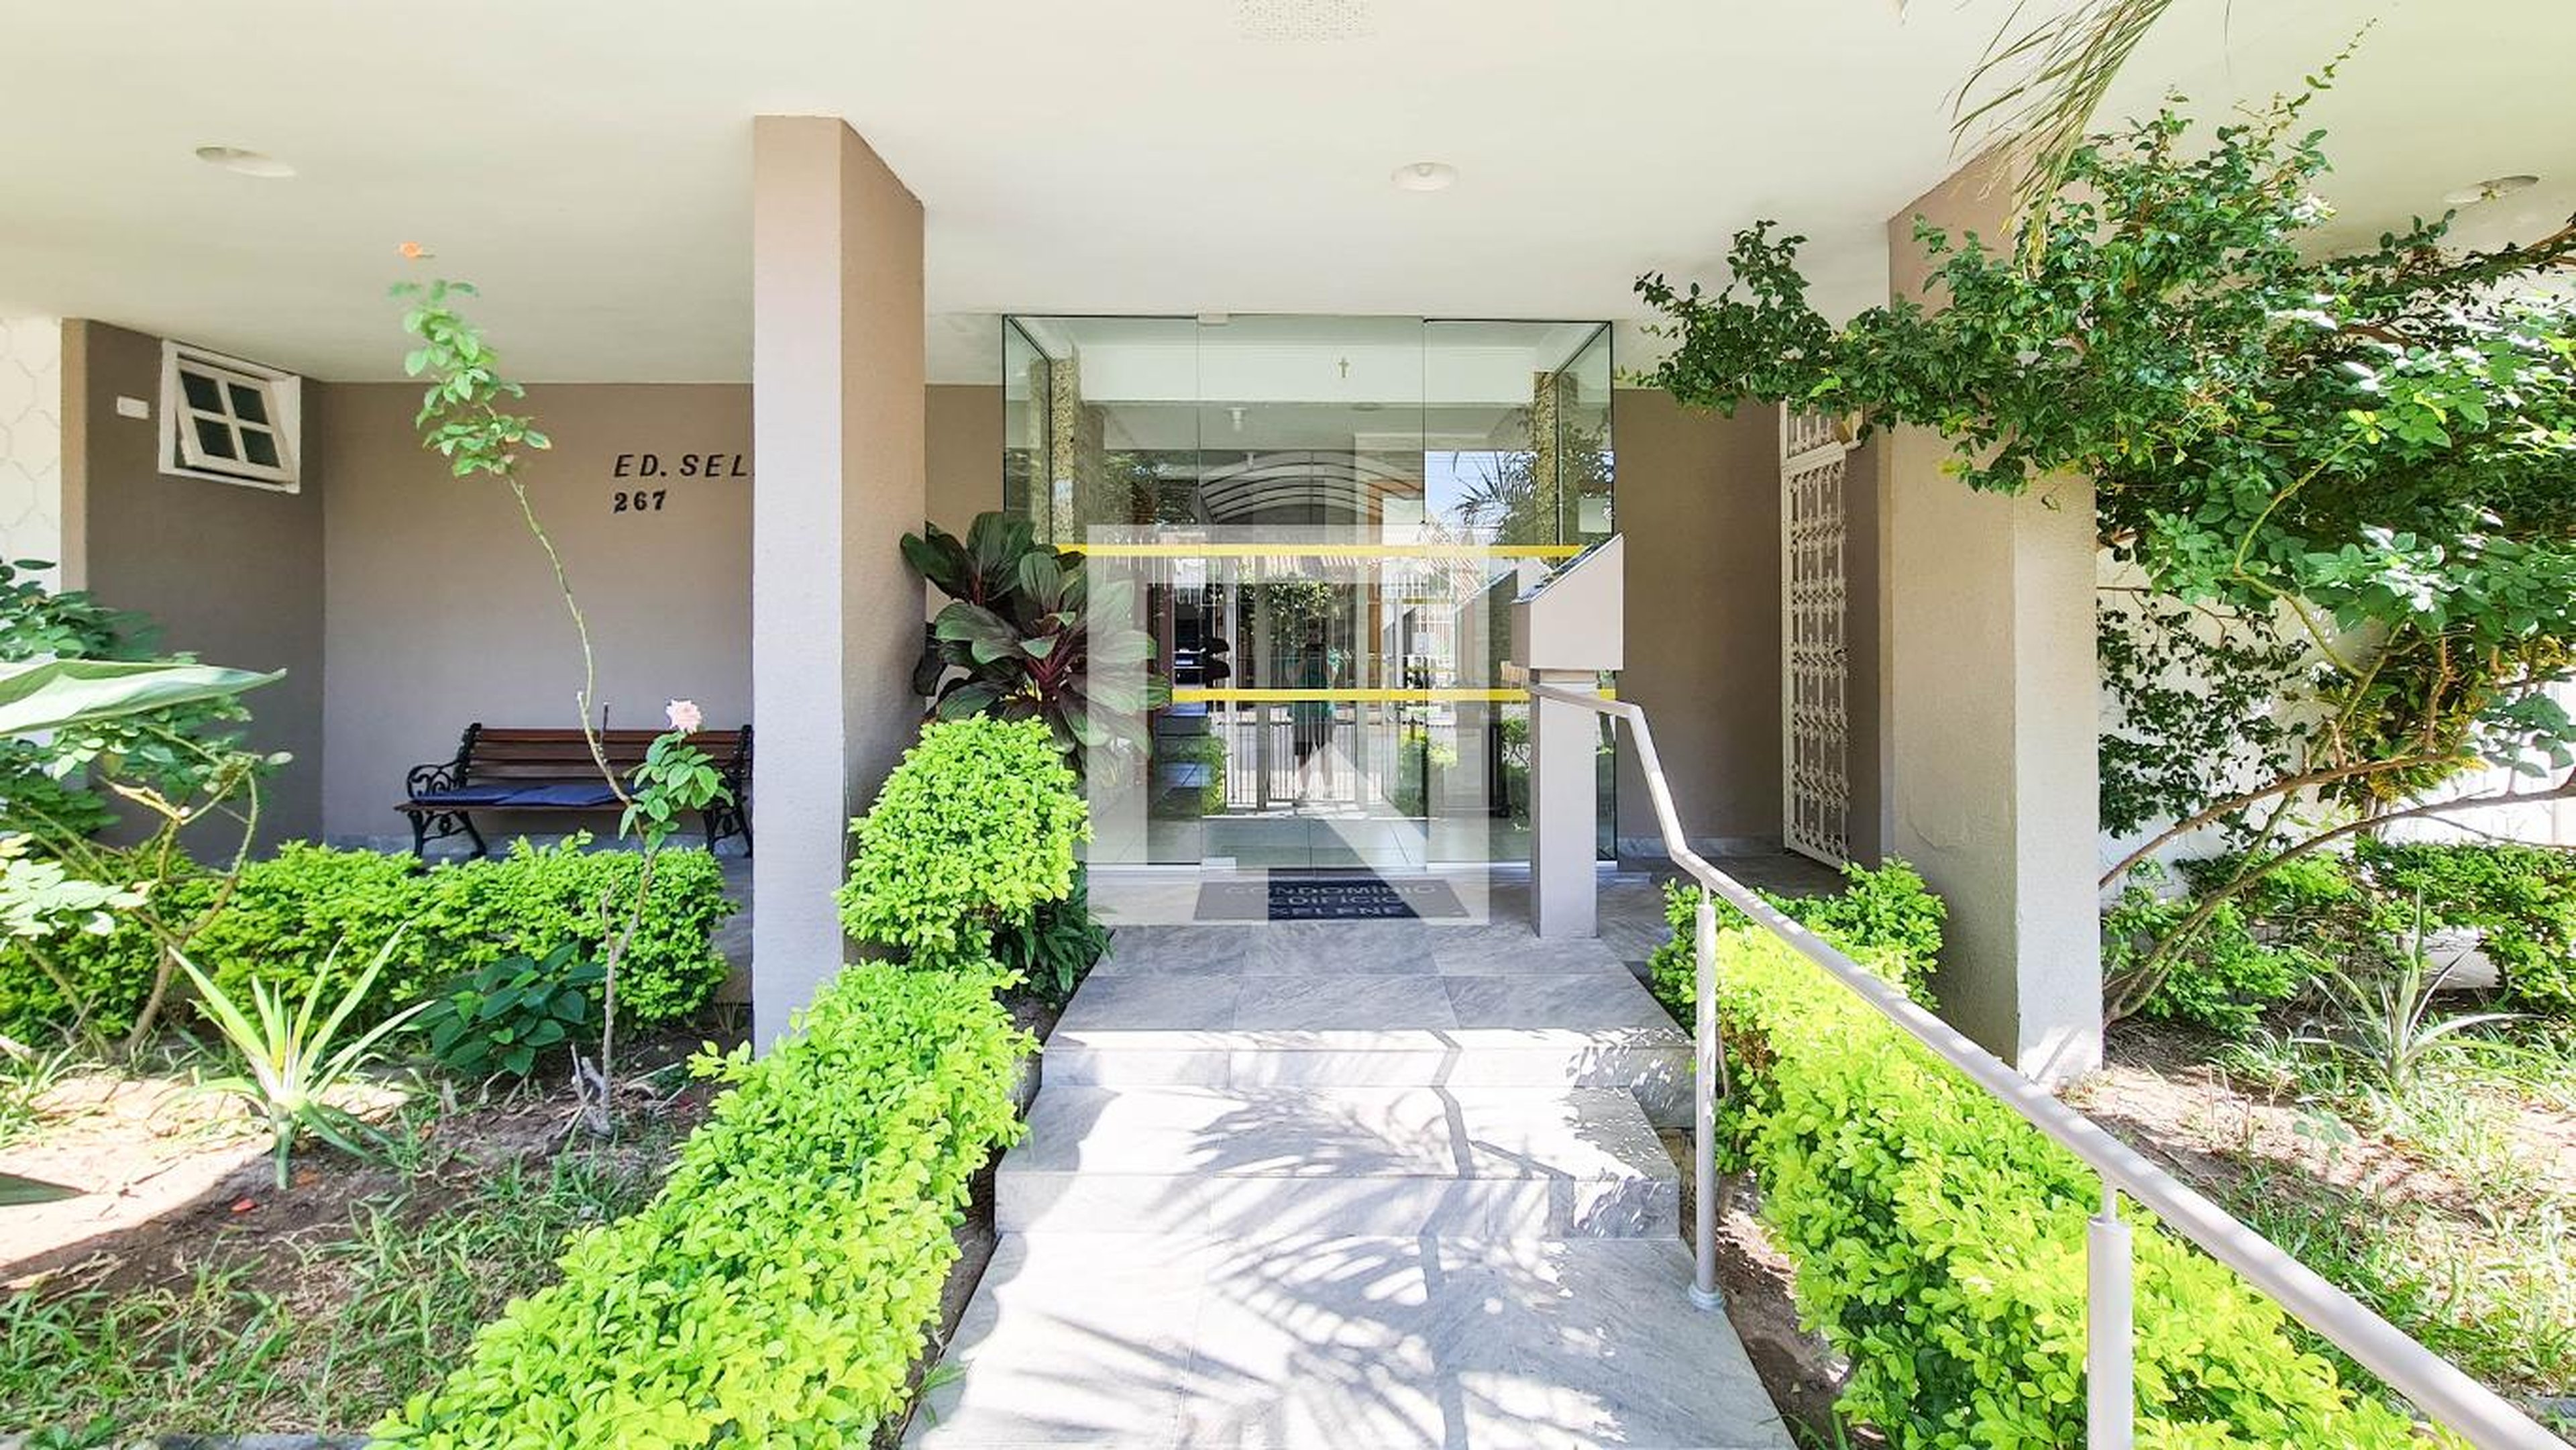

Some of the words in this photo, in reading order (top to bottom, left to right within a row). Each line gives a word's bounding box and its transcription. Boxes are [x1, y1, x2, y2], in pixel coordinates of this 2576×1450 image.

[614, 454, 667, 478] ED.
[679, 454, 754, 478] SEL
[613, 490, 666, 514] 267
